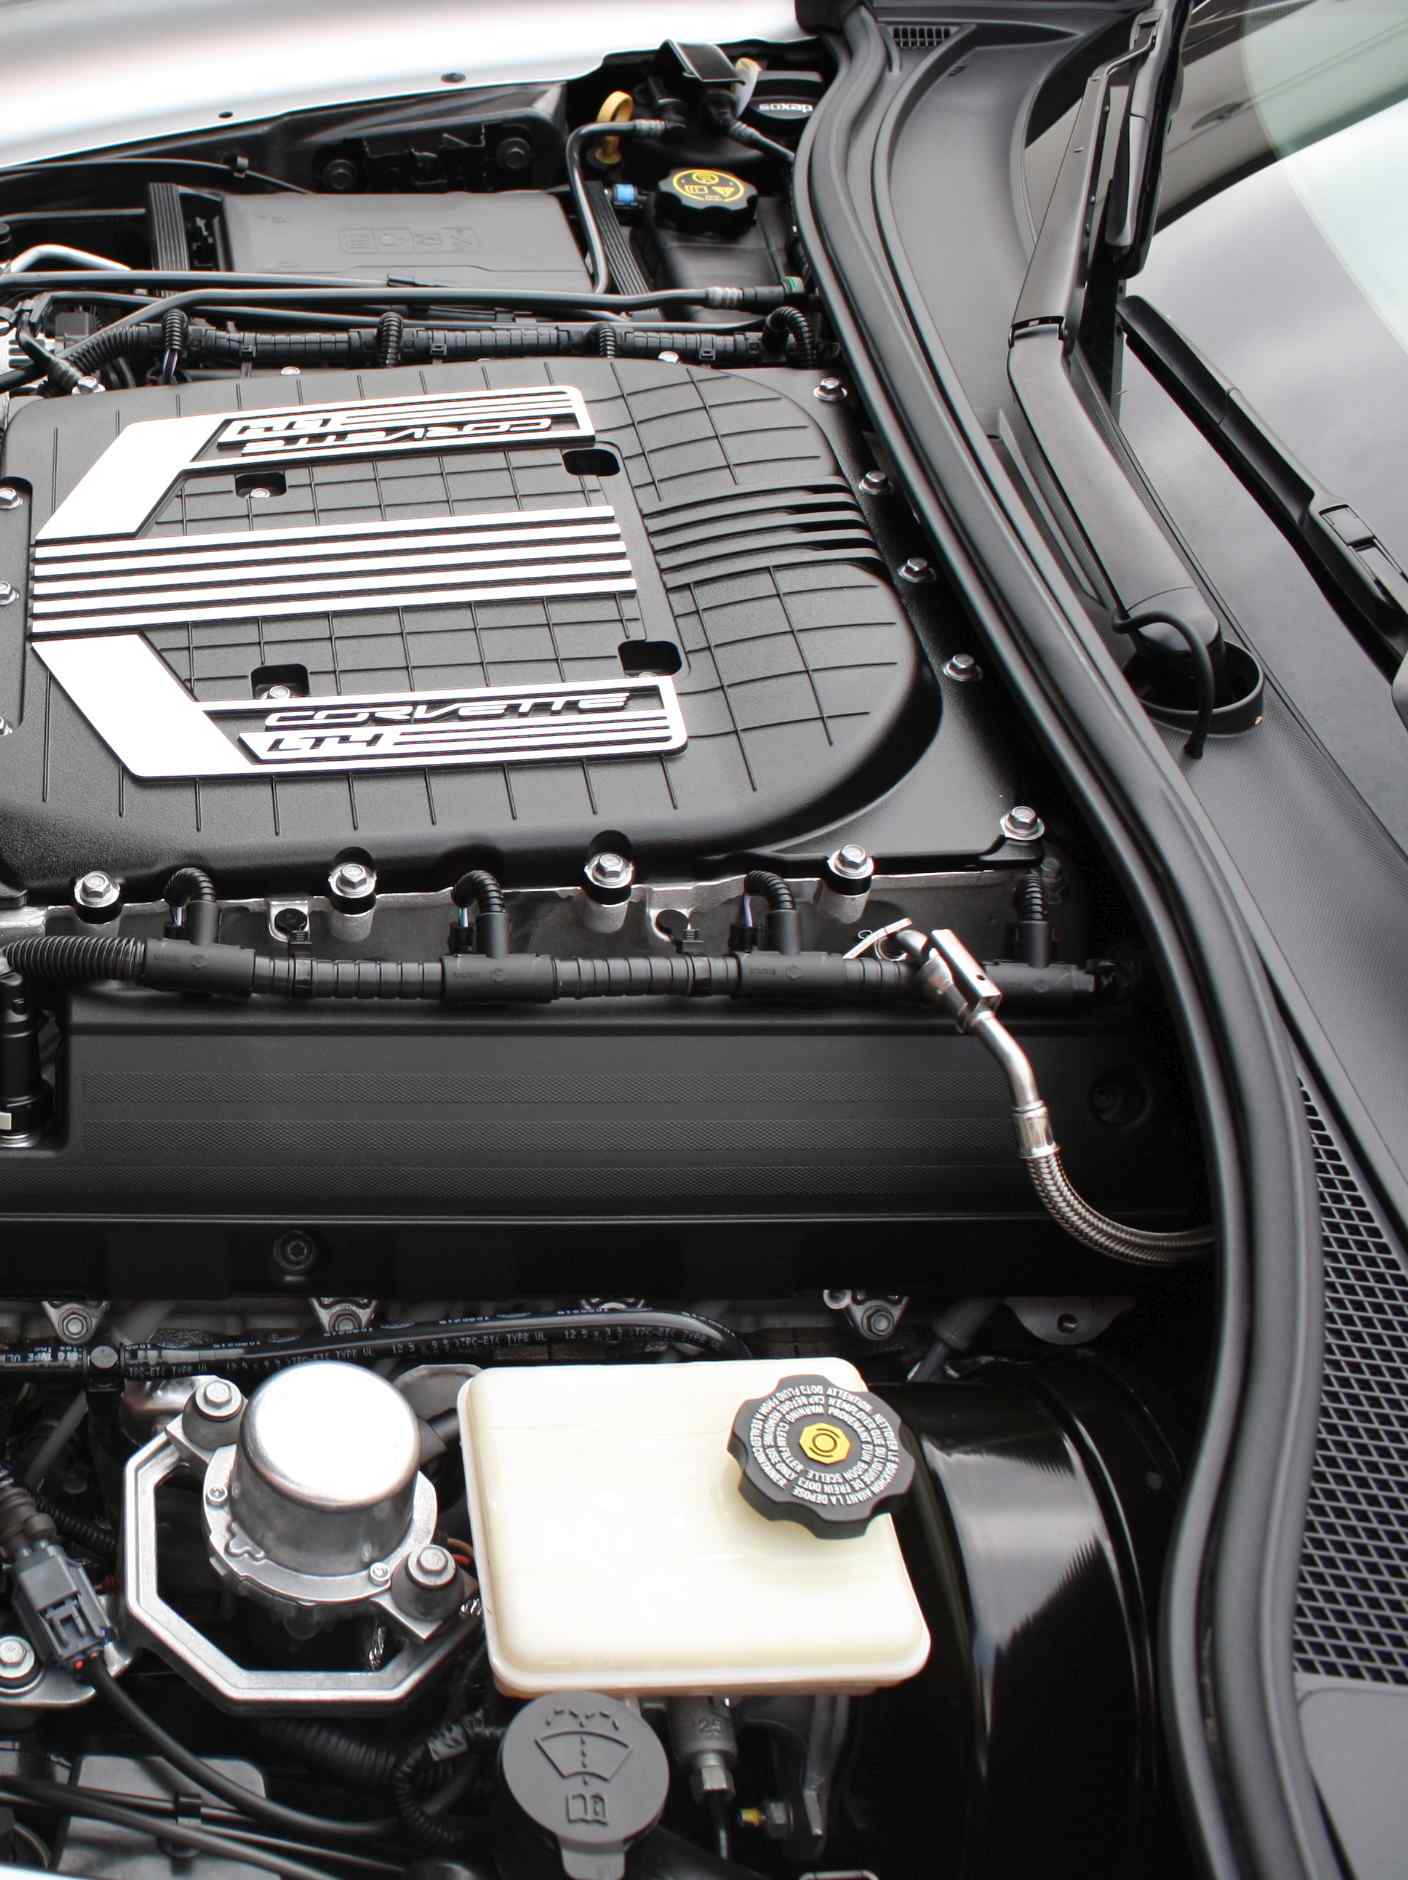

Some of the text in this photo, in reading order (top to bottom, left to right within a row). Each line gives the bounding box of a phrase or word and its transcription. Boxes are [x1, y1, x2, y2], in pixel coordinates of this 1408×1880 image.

[759, 103, 814, 113] dexos
[241, 416, 552, 454] CORVETTE
[265, 692, 630, 727] CORVETTE
[267, 733, 384, 752] LT4
[776, 1387, 800, 1402] FLUID
[799, 1385, 824, 1395] DOT3
[759, 1396, 780, 1415] FROM
[776, 1395, 806, 1414] BEFORE
[807, 1395, 825, 1405] CAP
[753, 1412, 766, 1420] A
[827, 1406, 872, 1442] PROVENANT
[750, 1419, 764, 1446] SEALED
[776, 1422, 790, 1446] CLEAN
[870, 1428, 886, 1445] QUE
[872, 1413, 899, 1450] NETTOYER
[766, 1448, 782, 1465] USE
[778, 1447, 804, 1473] FILLER
[874, 1446, 887, 1457] DU
[887, 1451, 900, 1462] LE
[776, 1463, 798, 1480] ONLY
[806, 1470, 844, 1483] SCELLE
[842, 1461, 869, 1481] BIDON
[860, 1457, 886, 1485] LIQUIDE
[870, 1461, 898, 1495] BOUCHON
[797, 1477, 822, 1492] DOT3
[823, 1483, 852, 1495] FREIN
[850, 1478, 866, 1491] DE
[829, 1494, 844, 1505] LA
[845, 1487, 873, 1505] AVANT
